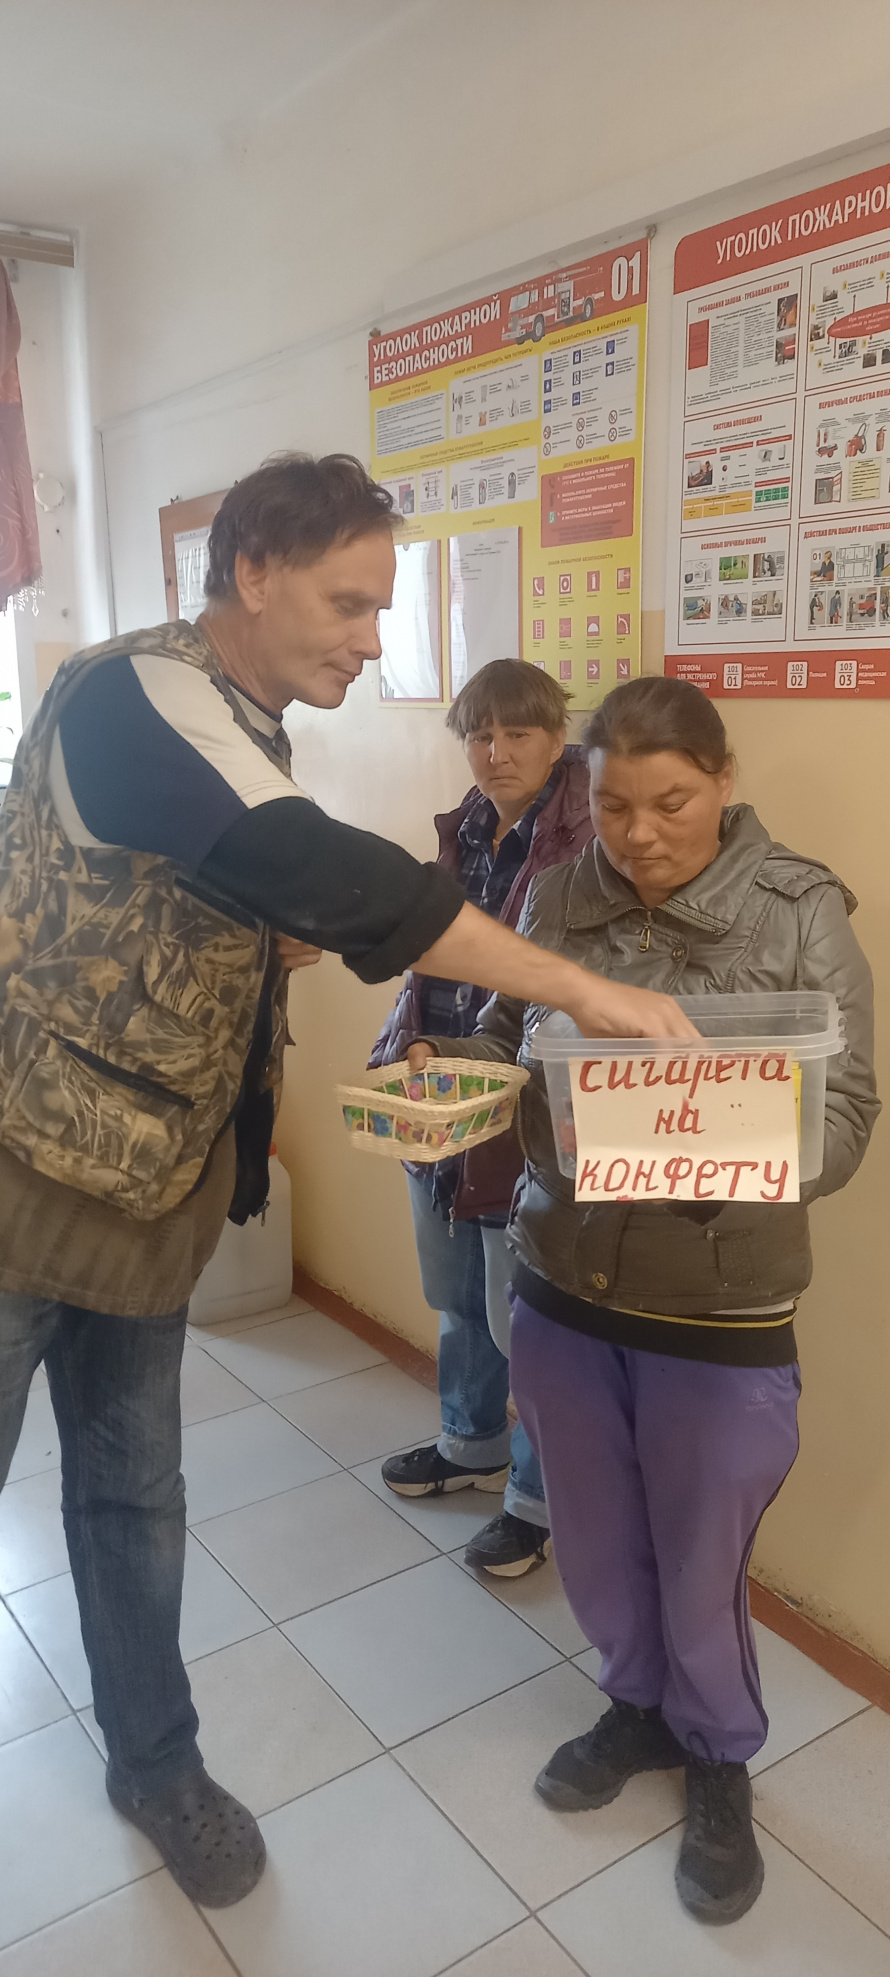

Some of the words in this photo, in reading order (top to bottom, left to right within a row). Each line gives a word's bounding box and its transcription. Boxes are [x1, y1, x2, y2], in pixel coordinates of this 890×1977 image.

[716, 219, 783, 264] УГОЛОК
[611, 251, 641, 301] 01
[373, 330, 419, 362] УГОЛОК
[422, 294, 501, 344] ПОЖАРНОЙ
[373, 335, 473, 384] БЕЗОПАСНОСТИ
[792, 664, 804, 672] 102
[840, 662, 852, 671] 103
[727, 676, 738, 686] 01
[790, 675, 803, 686] 02
[838, 674, 852, 686] 03
[654, 1104, 706, 1135] на
